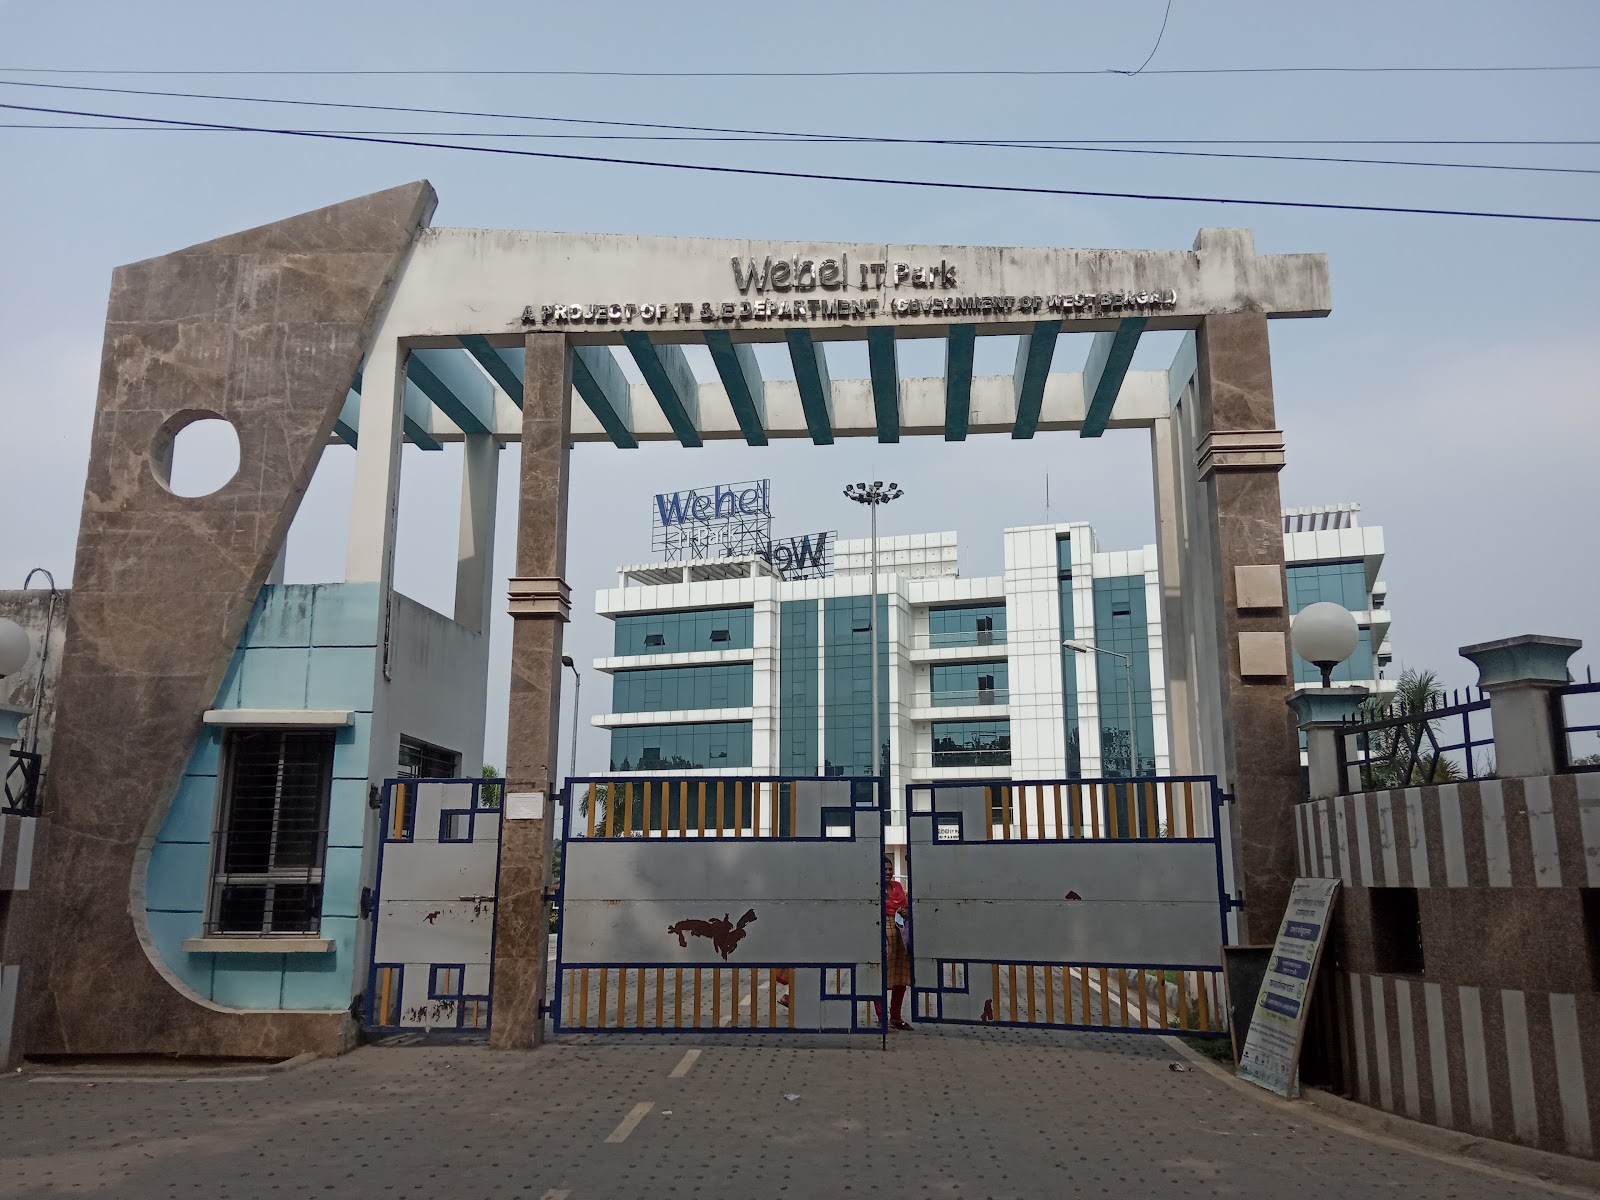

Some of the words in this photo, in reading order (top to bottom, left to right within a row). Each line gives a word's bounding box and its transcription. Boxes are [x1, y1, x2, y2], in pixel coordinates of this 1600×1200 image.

[859, 263, 885, 291] IT
[893, 260, 957, 290] Park
[521, 305, 536, 325] A
[541, 303, 637, 325] PROJECT
[640, 303, 667, 324] OF
[673, 302, 694, 324] IT
[700, 302, 715, 322] &
[740, 298, 881, 322] DEPARTMENT
[891, 296, 1015, 319] (GOVERNMENT
[1020, 295, 1043, 316] OF
[1048, 291, 1097, 313] WEST
[1099, 289, 1177, 311] BENGAL)
[697, 523, 738, 547] Park
